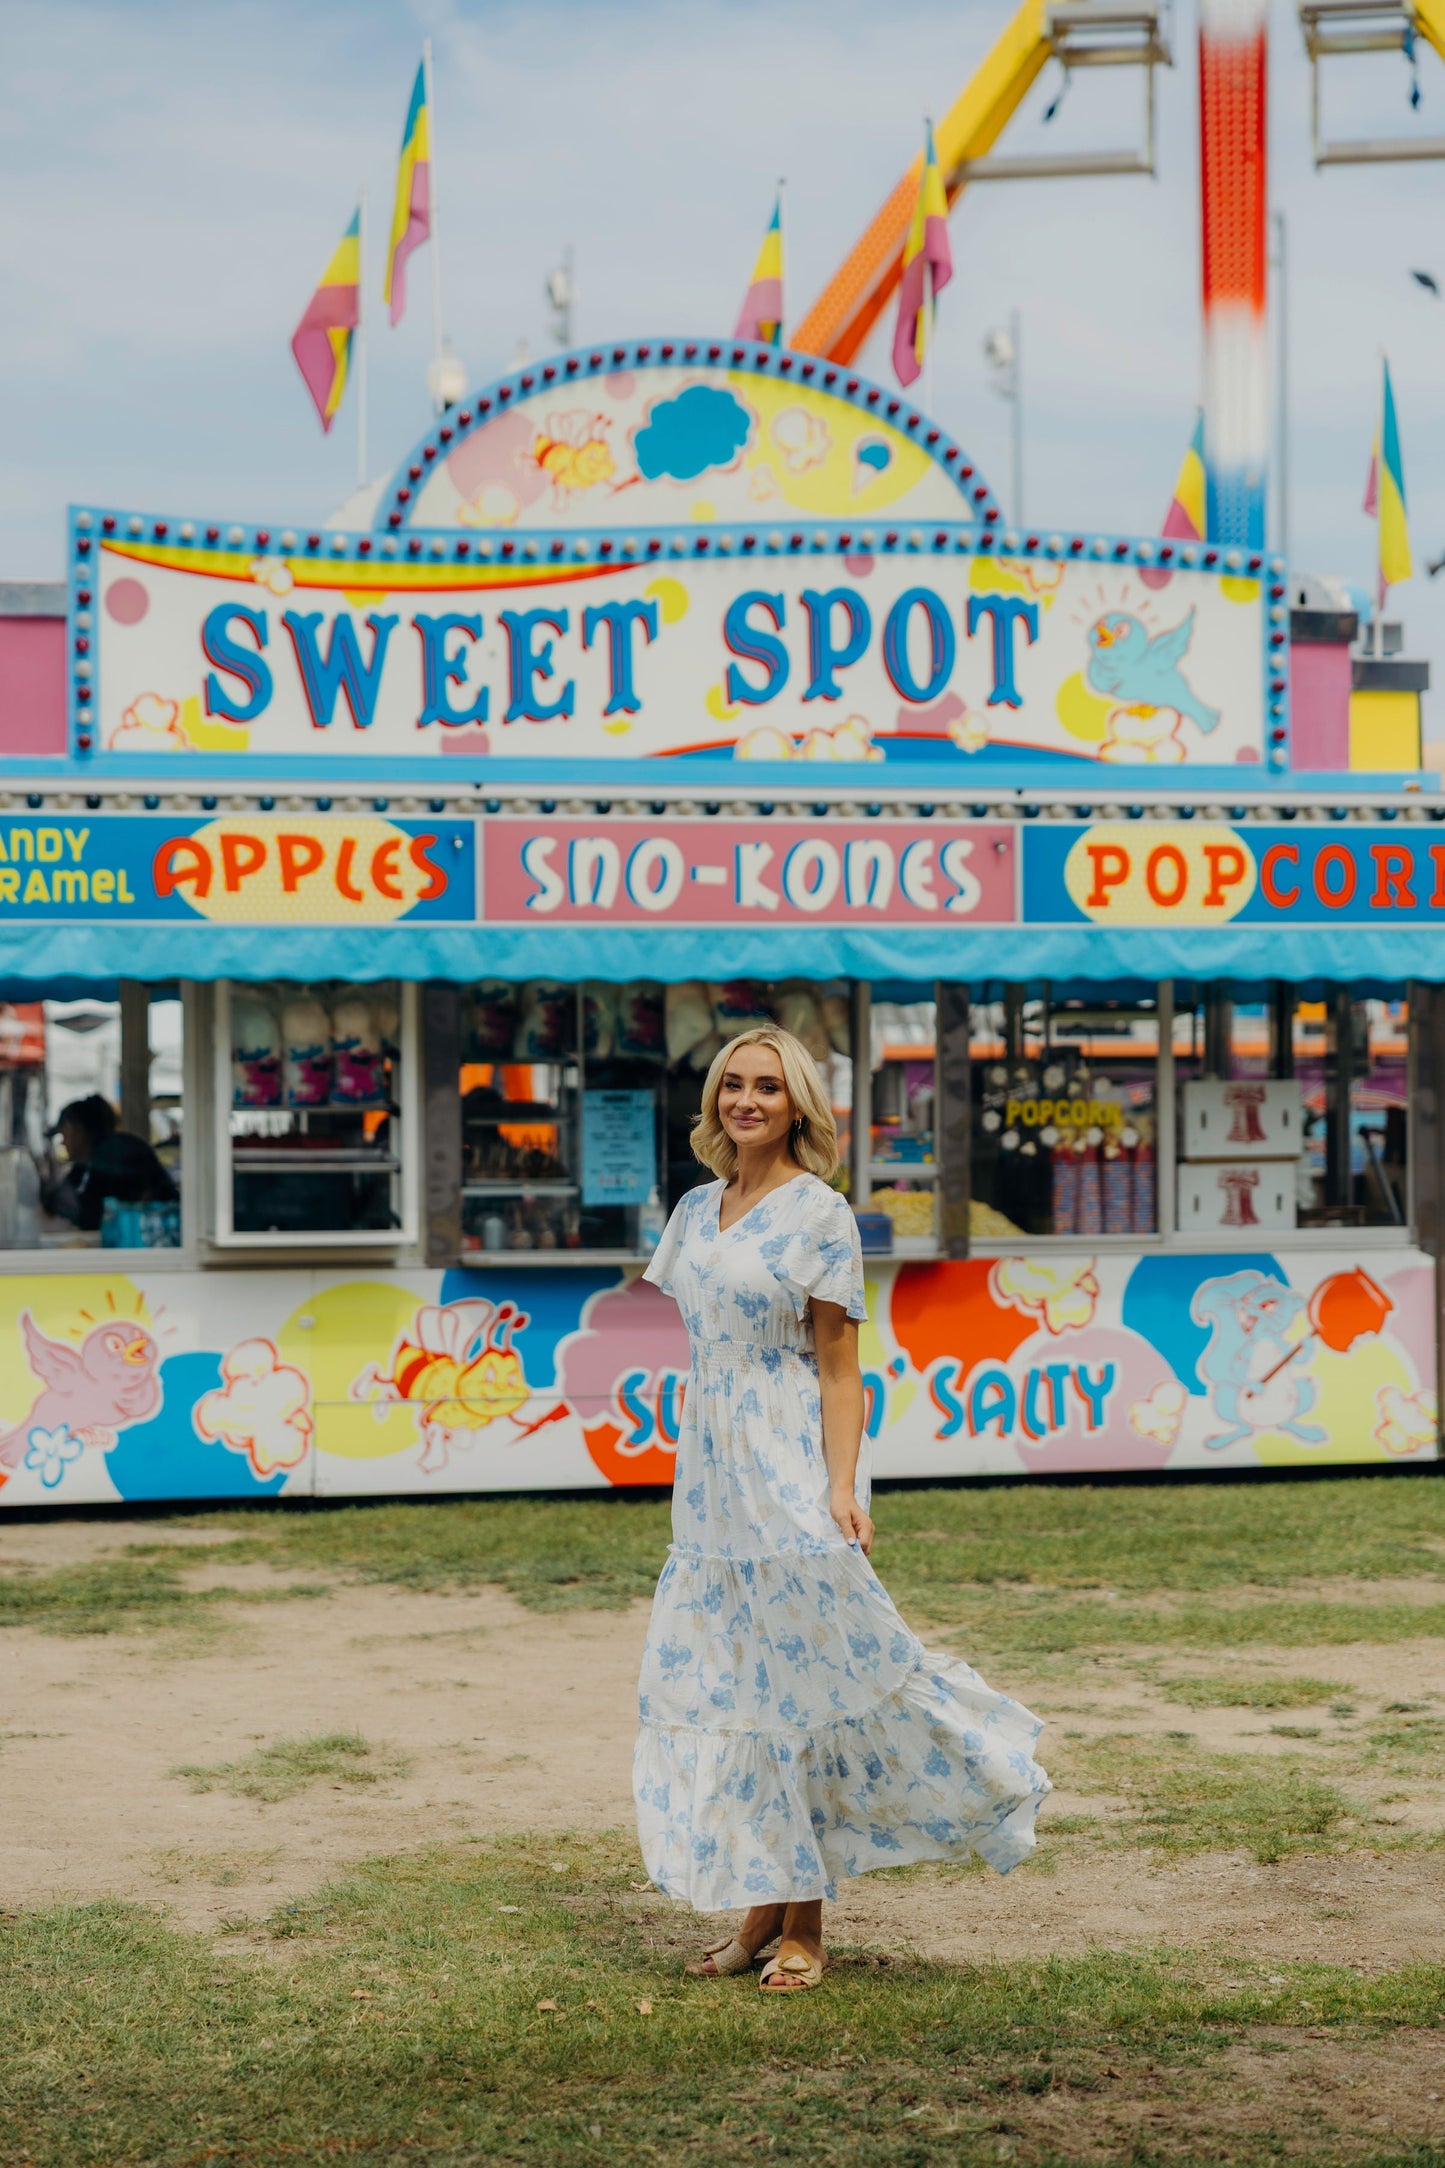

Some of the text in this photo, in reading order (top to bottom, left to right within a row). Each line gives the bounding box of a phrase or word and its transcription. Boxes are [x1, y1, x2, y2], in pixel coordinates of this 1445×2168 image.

[201, 586, 1039, 729] SWEET SPOT
[153, 833, 448, 902] APPLES
[1086, 843, 1445, 909] POPCOR
[1006, 1099, 1122, 1127] POPCORN
[929, 1362, 1116, 1441] SALTY
